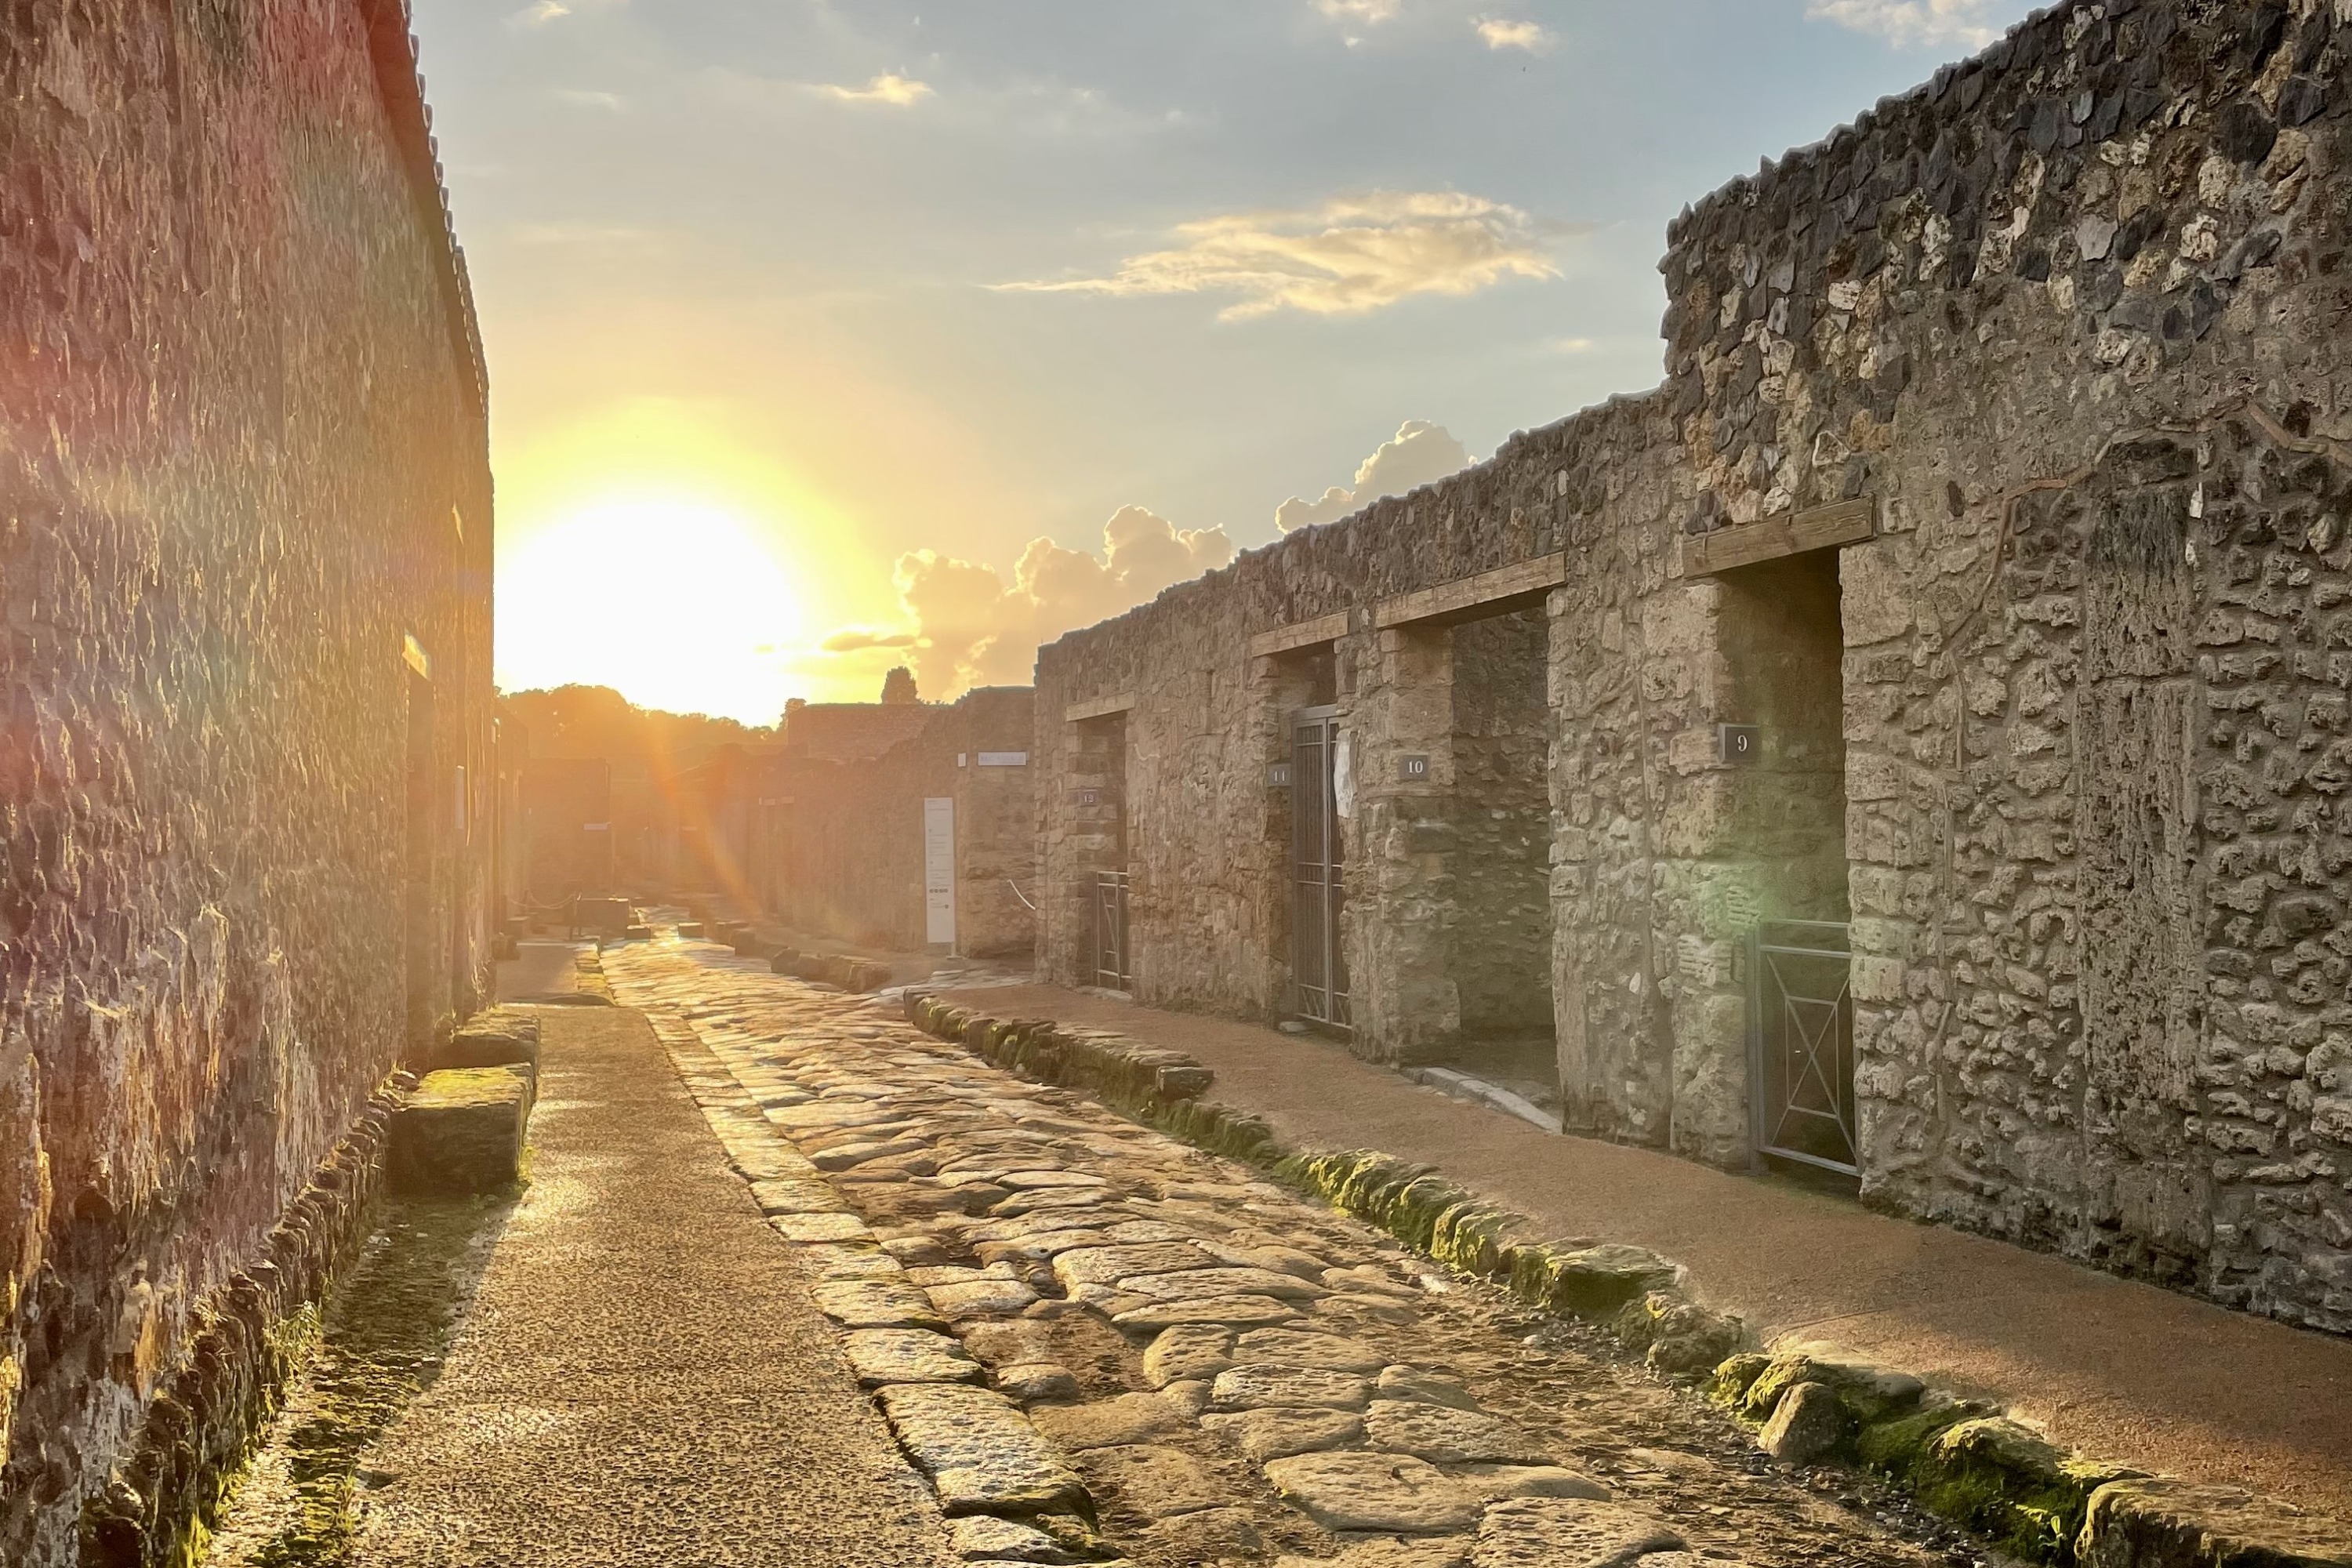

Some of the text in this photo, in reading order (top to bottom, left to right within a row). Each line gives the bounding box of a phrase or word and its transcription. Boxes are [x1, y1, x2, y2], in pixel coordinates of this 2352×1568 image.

[1737, 735, 1748, 752] 9
[1409, 760, 1423, 773] 10
[1274, 771, 1285, 782] 11
